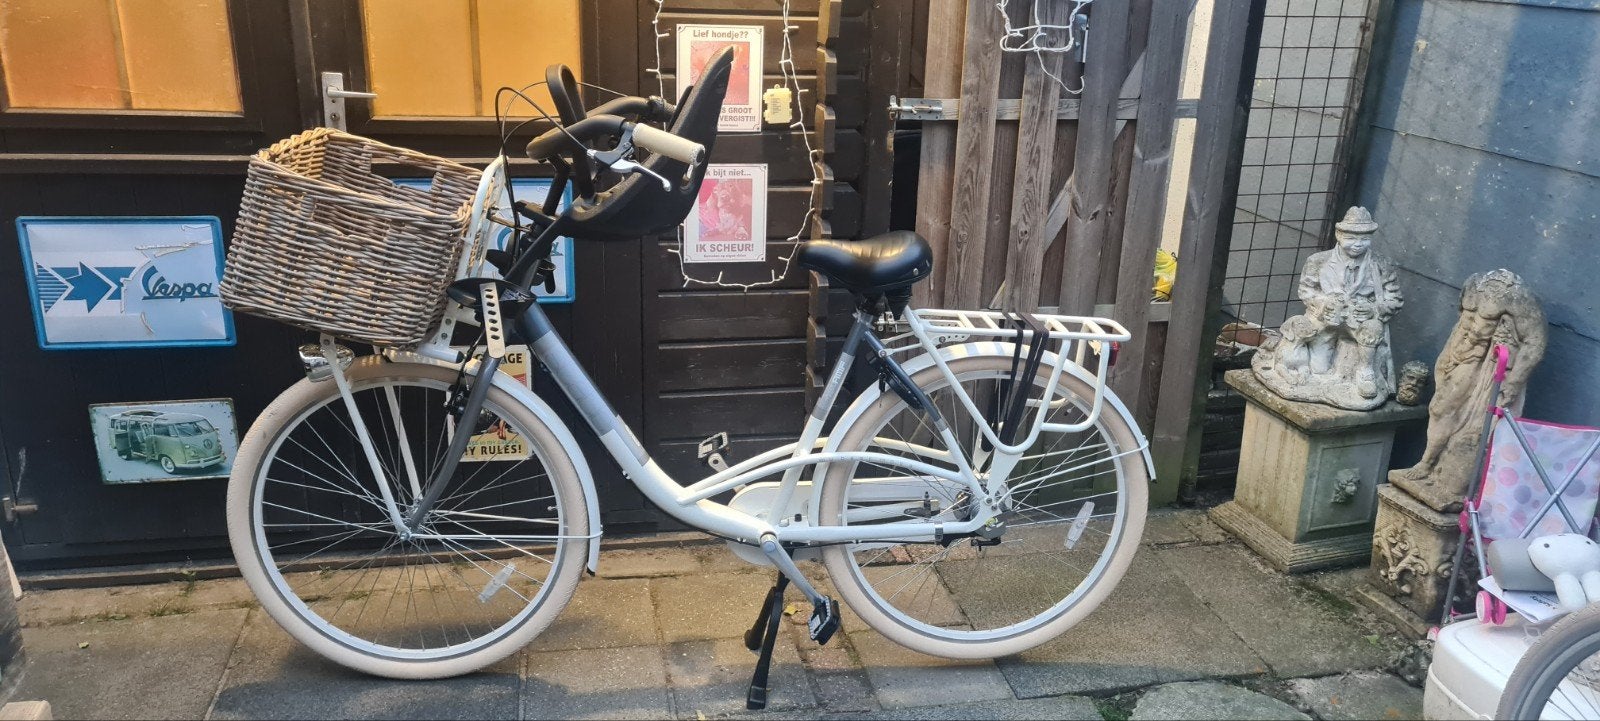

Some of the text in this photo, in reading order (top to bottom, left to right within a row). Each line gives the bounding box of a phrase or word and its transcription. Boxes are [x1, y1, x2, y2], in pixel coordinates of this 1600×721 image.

[693, 30, 749, 40] Lief hondje??
[713, 168, 727, 178] bijt
[728, 168, 752, 176] niet...
[695, 243, 754, 253] IK SCHEUR!
[141, 265, 214, 302] Vespa
[465, 444, 522, 456] Y RULES!
